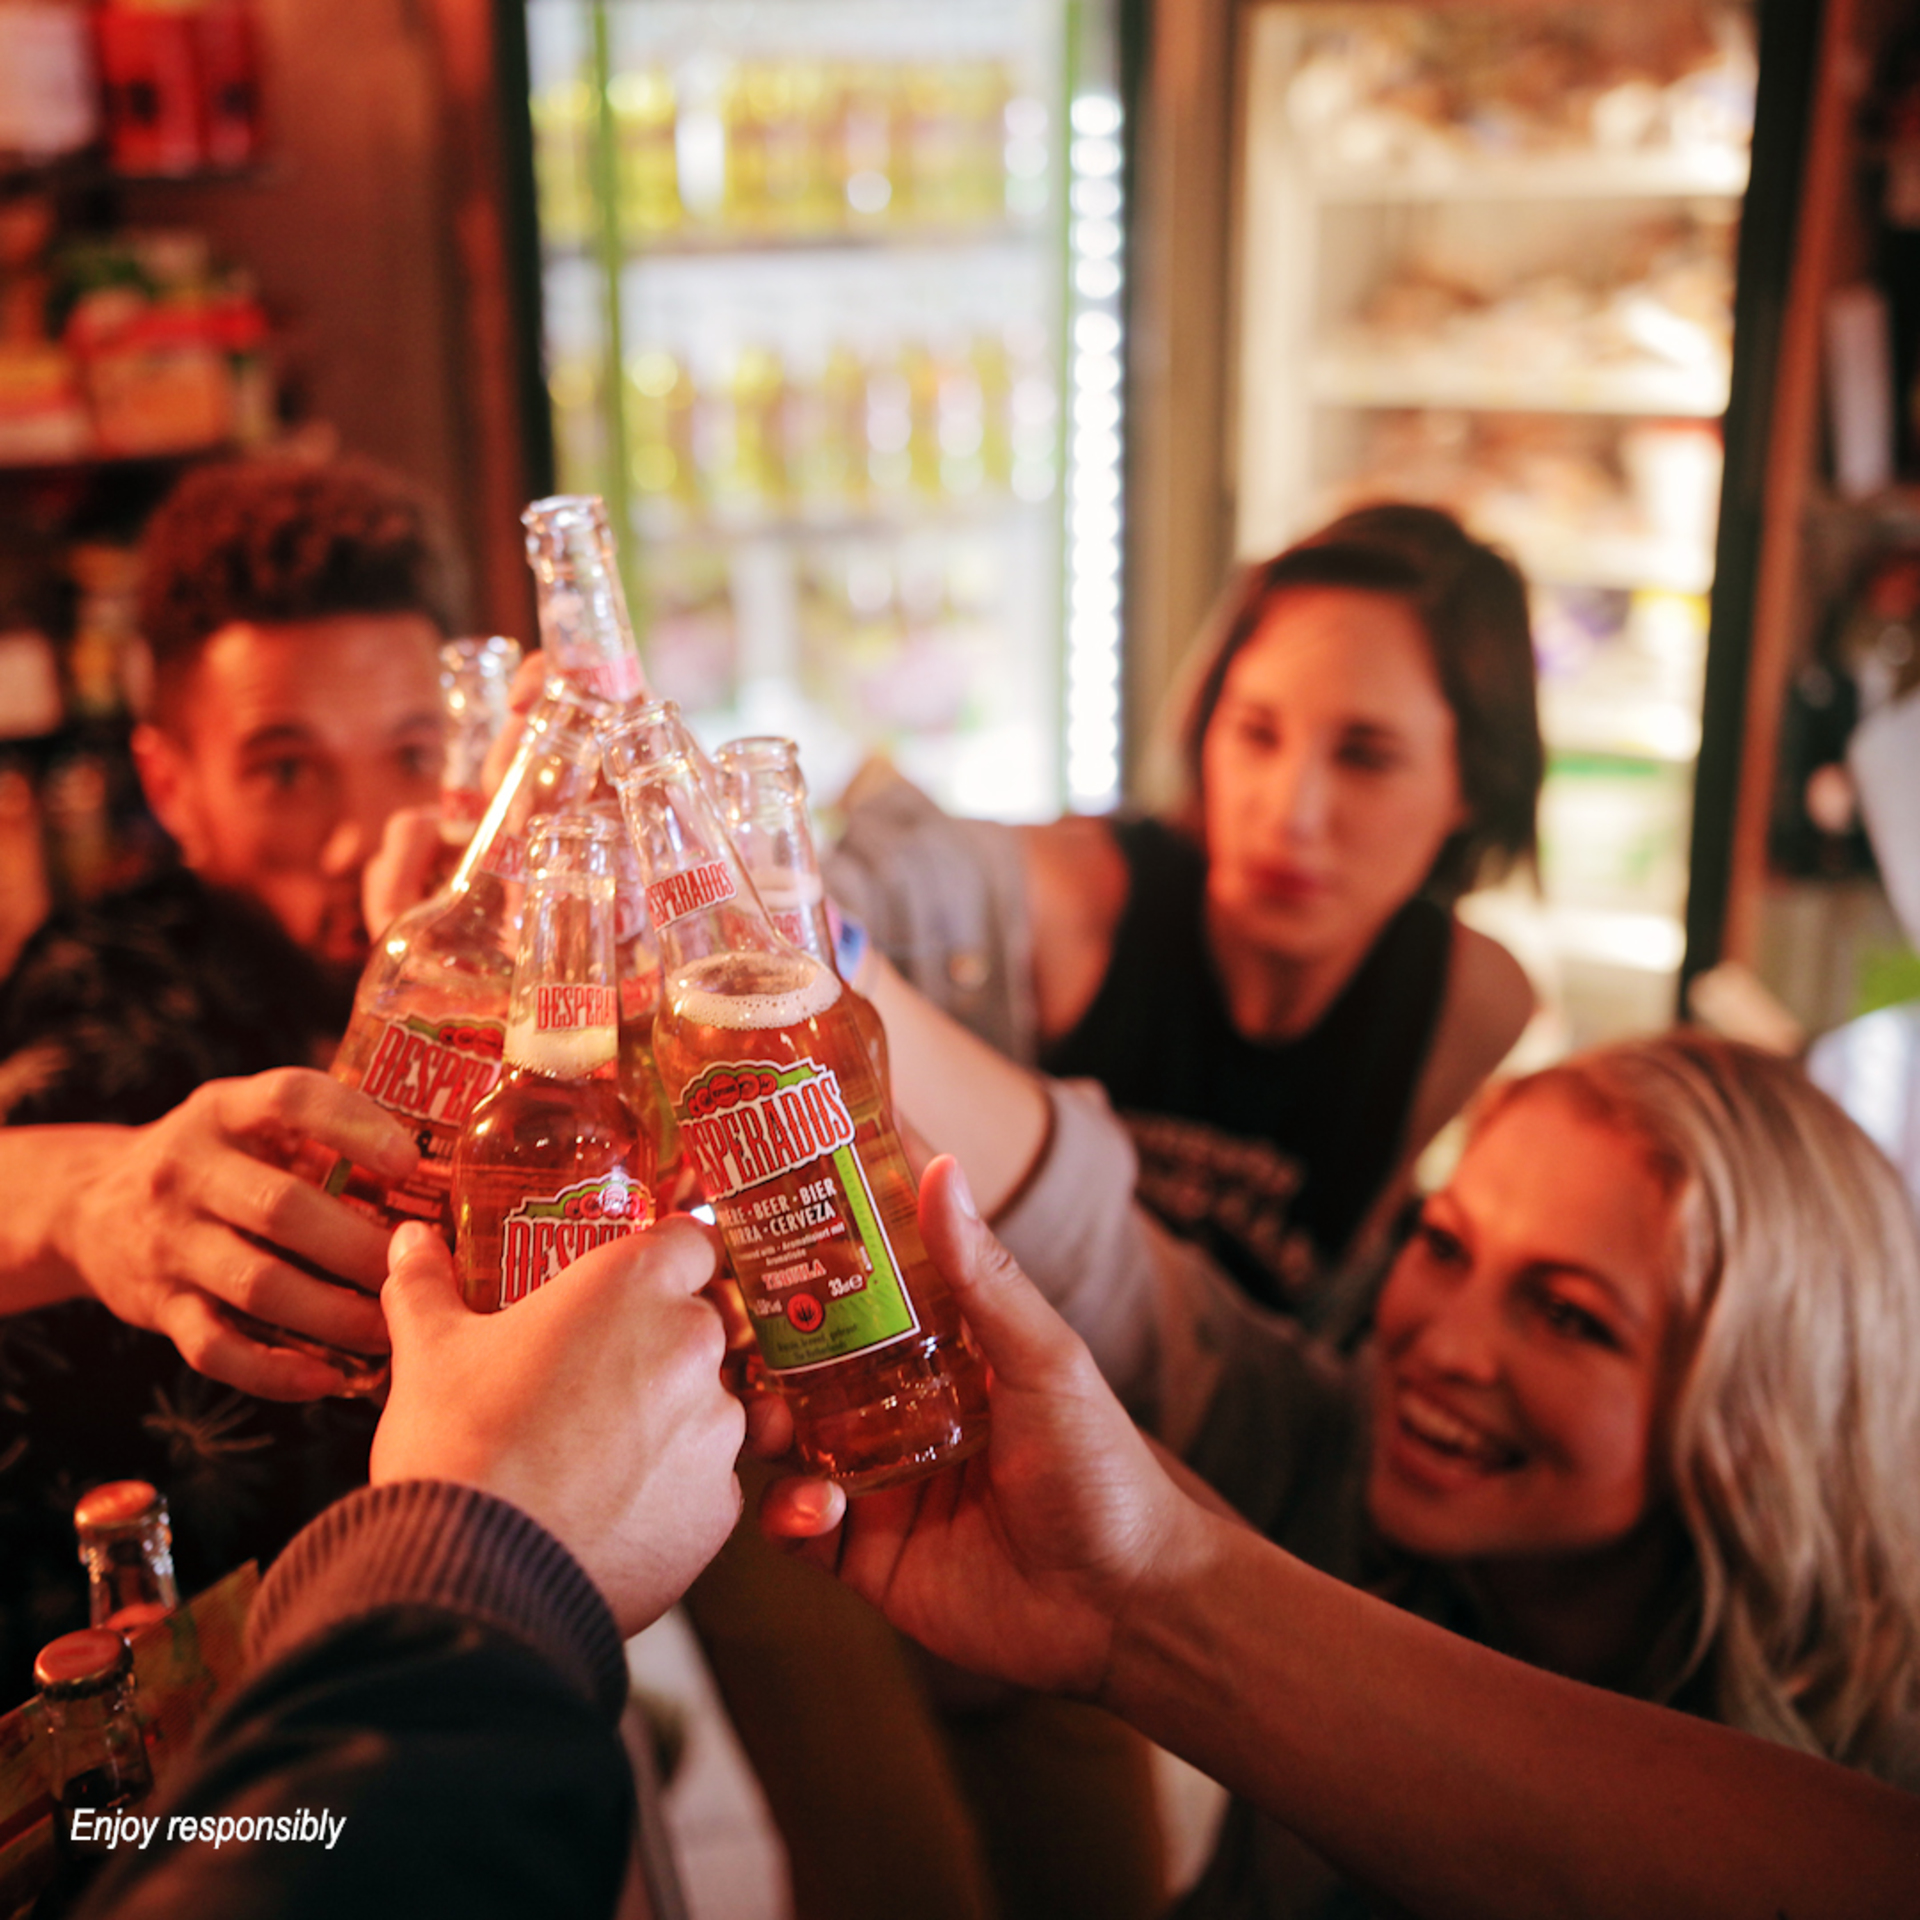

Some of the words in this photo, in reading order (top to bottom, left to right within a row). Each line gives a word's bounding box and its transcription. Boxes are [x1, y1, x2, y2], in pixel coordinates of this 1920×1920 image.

[753, 1194, 790, 1220] BEER
[799, 1177, 837, 1206] BIER
[769, 1200, 836, 1237] CERVEZA
